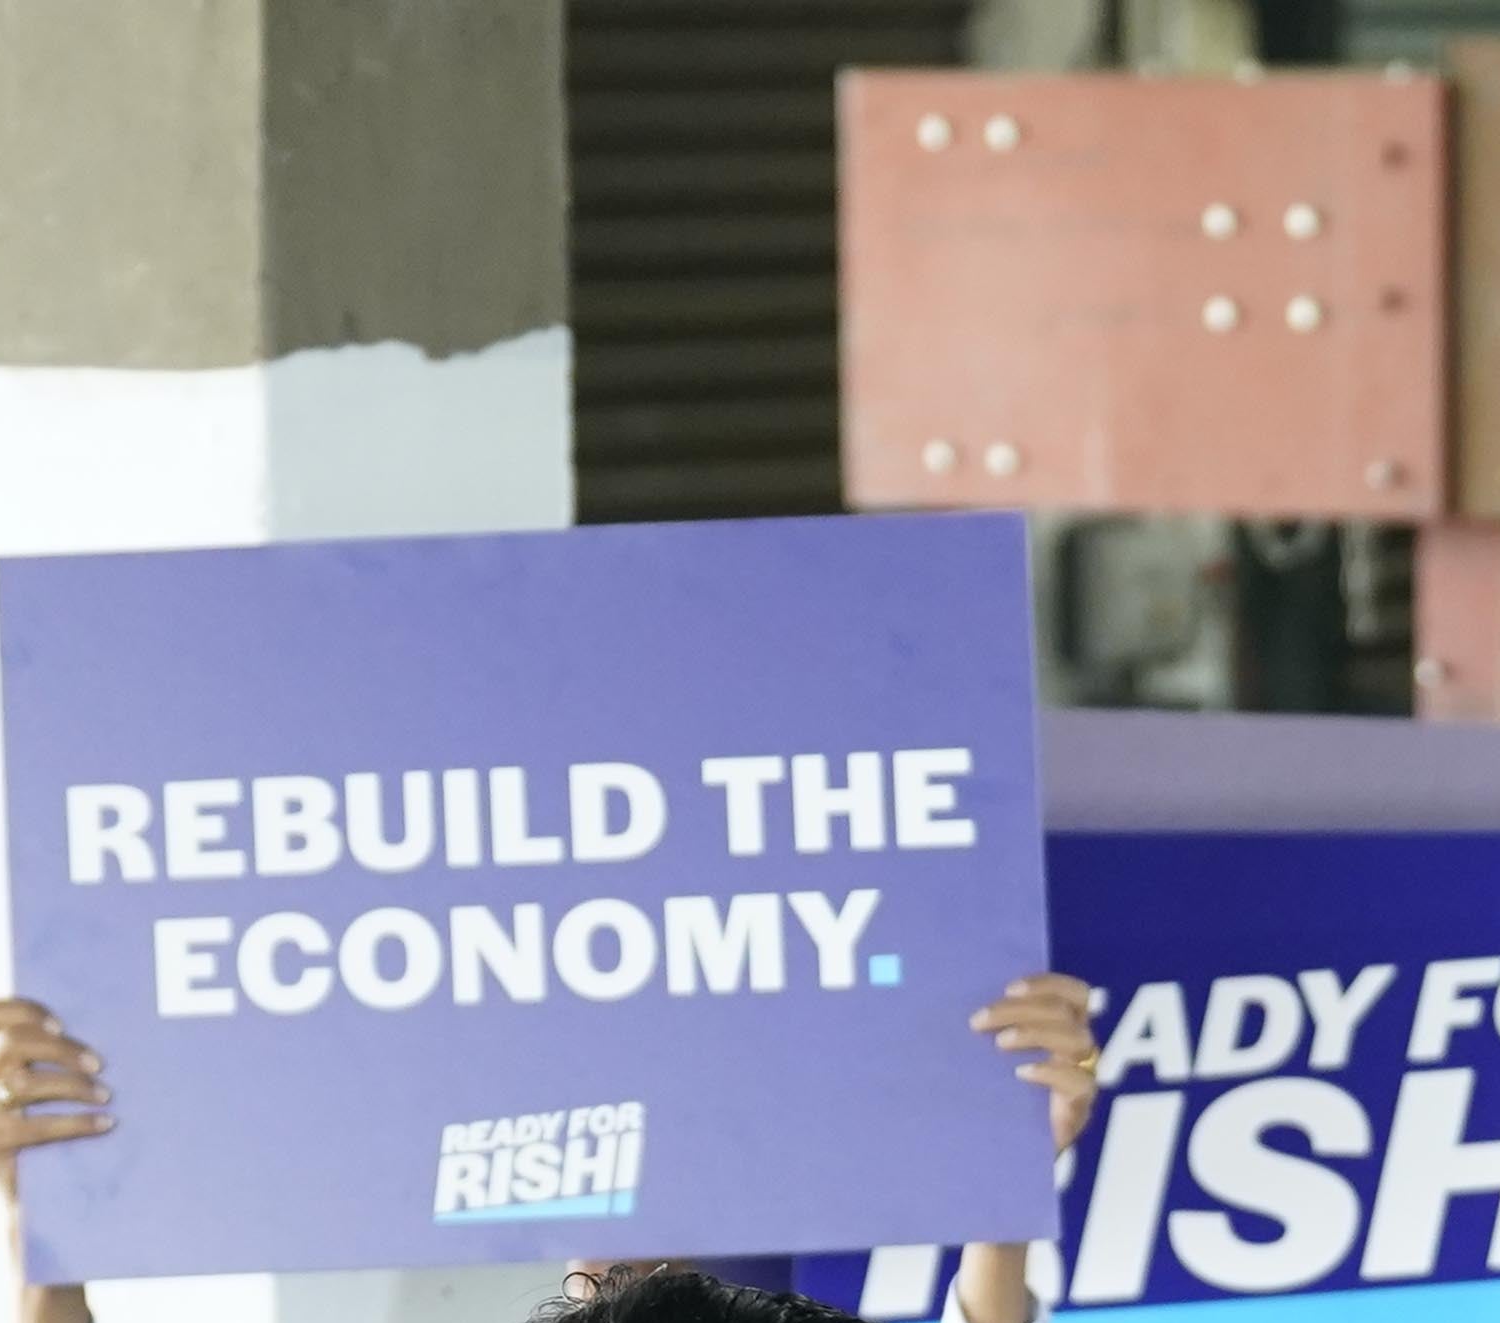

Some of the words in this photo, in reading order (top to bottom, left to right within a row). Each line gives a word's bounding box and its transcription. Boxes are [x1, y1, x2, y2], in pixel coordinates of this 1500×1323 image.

[64, 762, 667, 882] REBUILD
[701, 747, 976, 855] THE
[153, 889, 903, 1019] ECONOMY.
[1088, 964, 1396, 1085] ADY
[440, 1109, 565, 1154] READY
[566, 1101, 644, 1140] FOR
